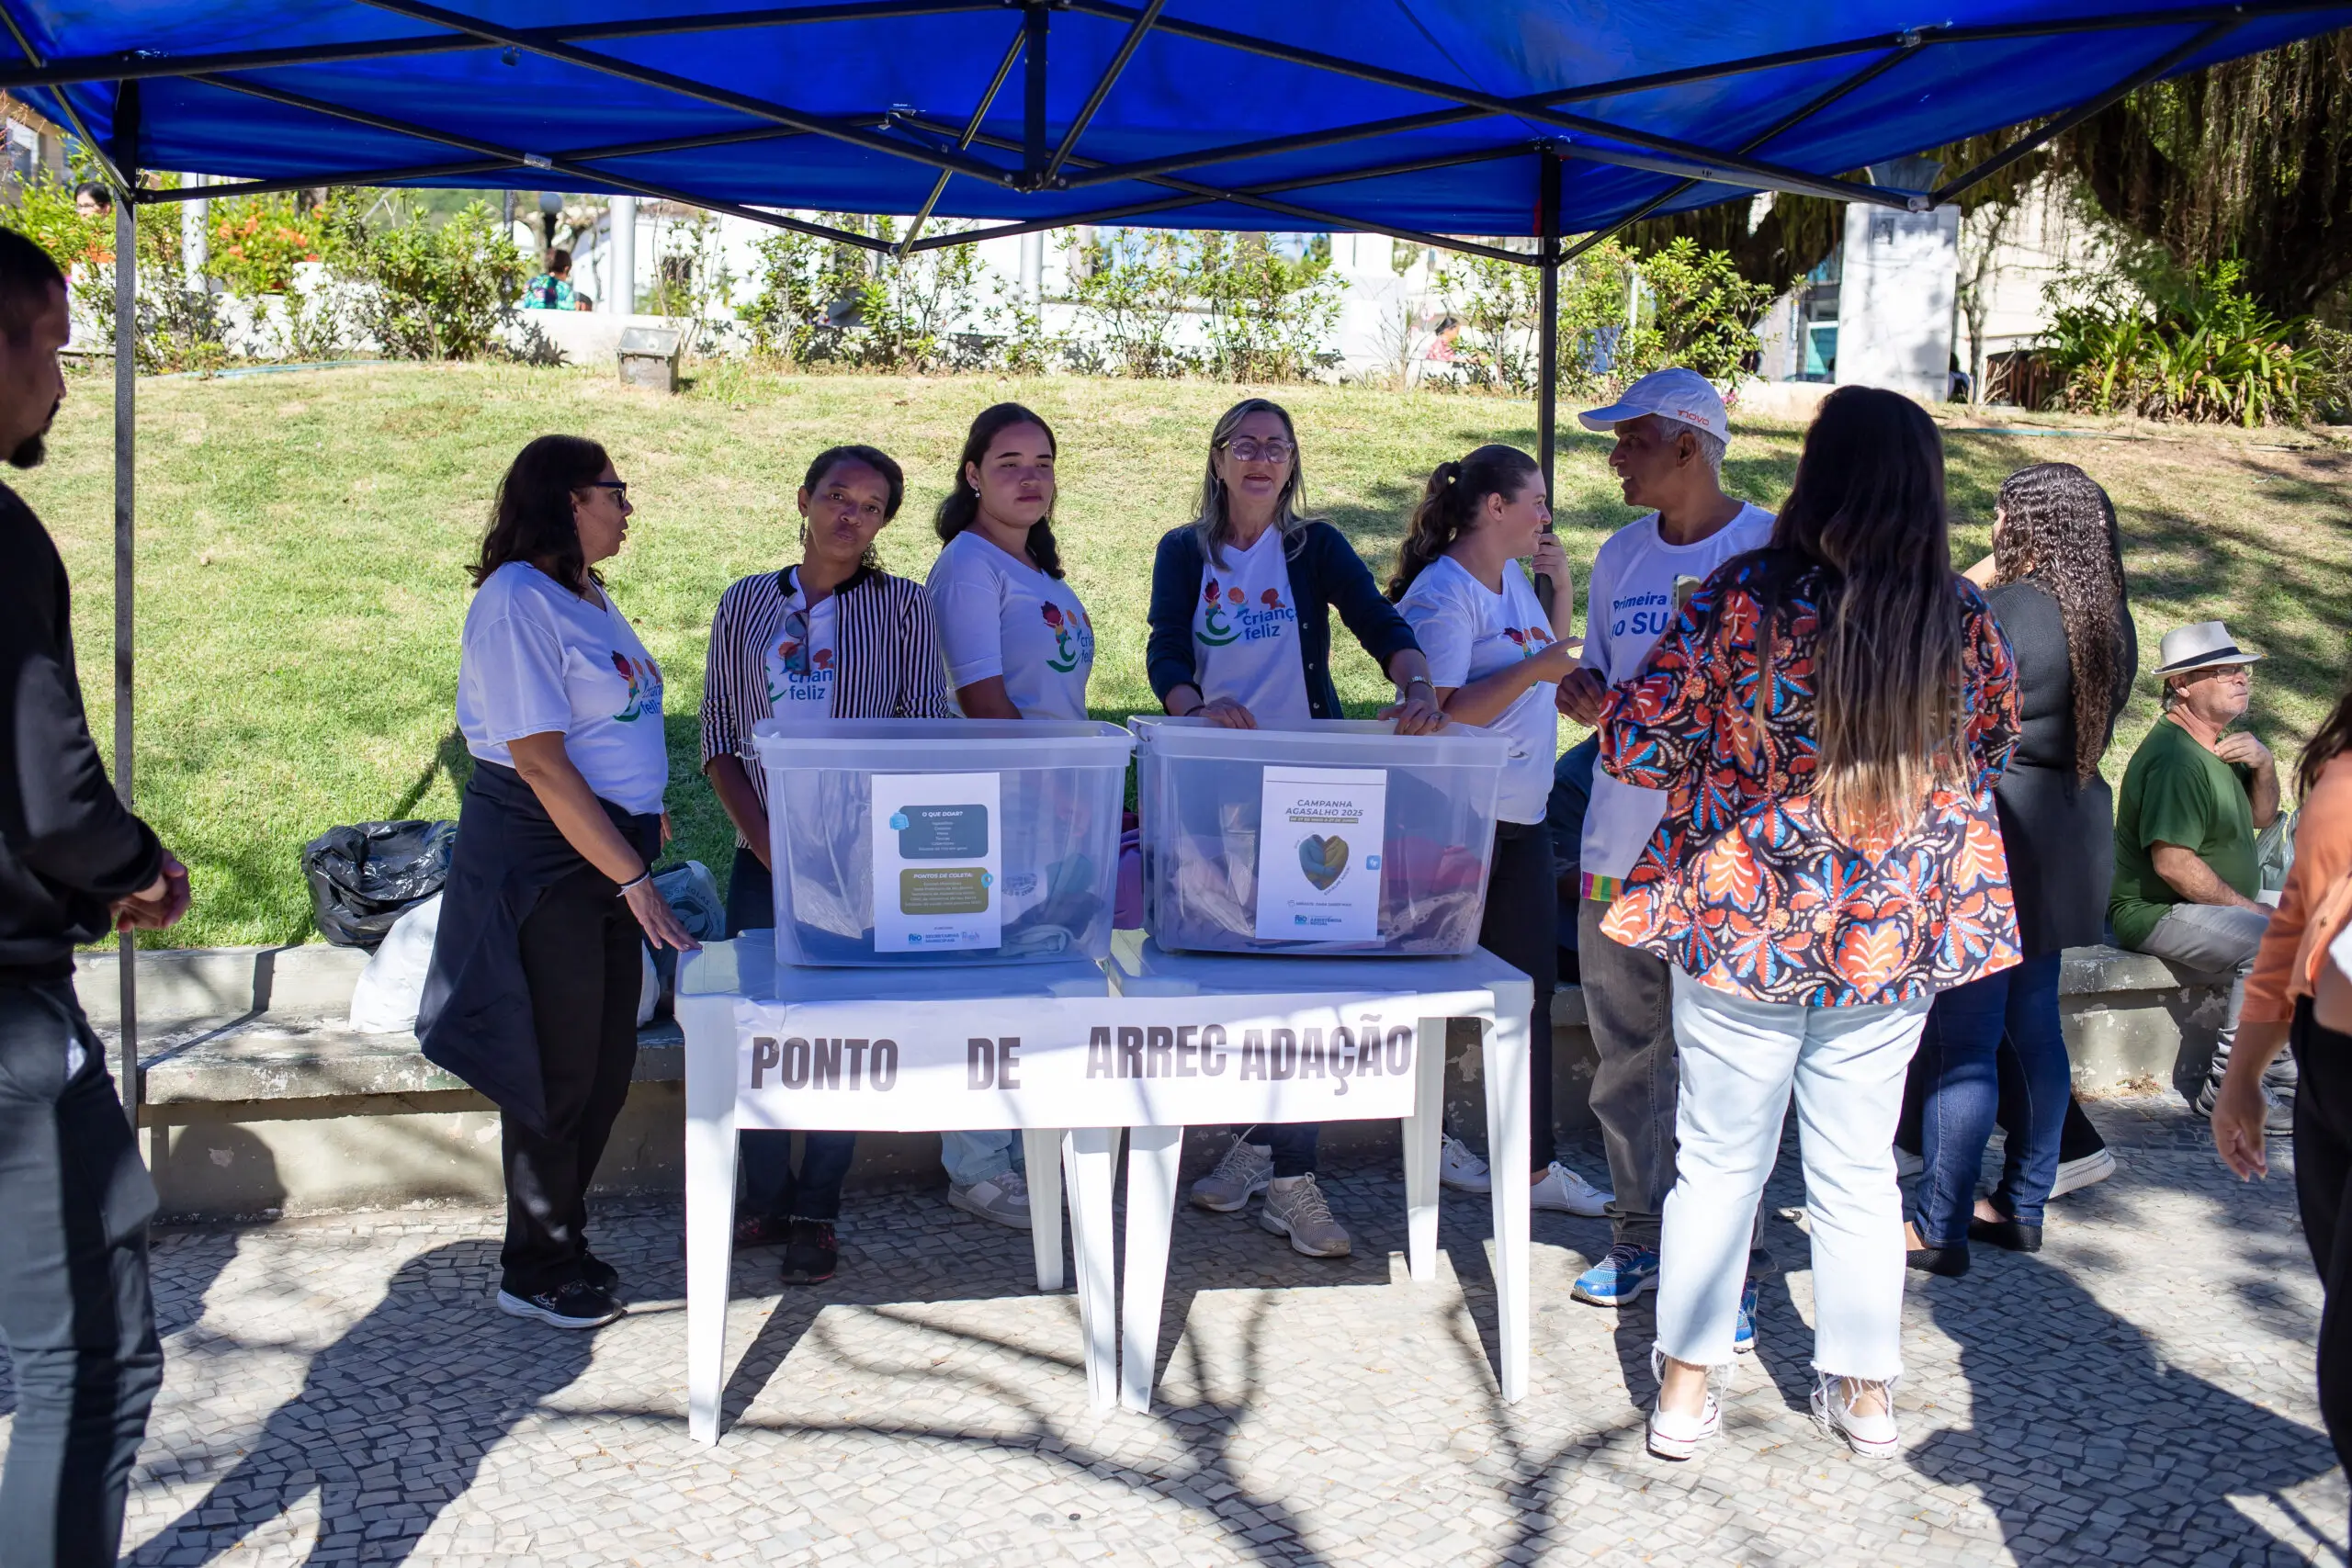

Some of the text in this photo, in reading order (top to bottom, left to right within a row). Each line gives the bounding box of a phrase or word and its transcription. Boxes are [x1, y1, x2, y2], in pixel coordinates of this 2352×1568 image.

[1612, 591, 1668, 614] Primeira
[1242, 607, 1296, 626] crianç
[1244, 623, 1280, 640] feliz
[789, 684, 825, 700] feliz
[1285, 807, 1339, 816] AGASALHO
[1297, 799, 1352, 807] CAMPANHA
[751, 1036, 899, 1091] PONTO
[967, 1036, 1021, 1090] DE
